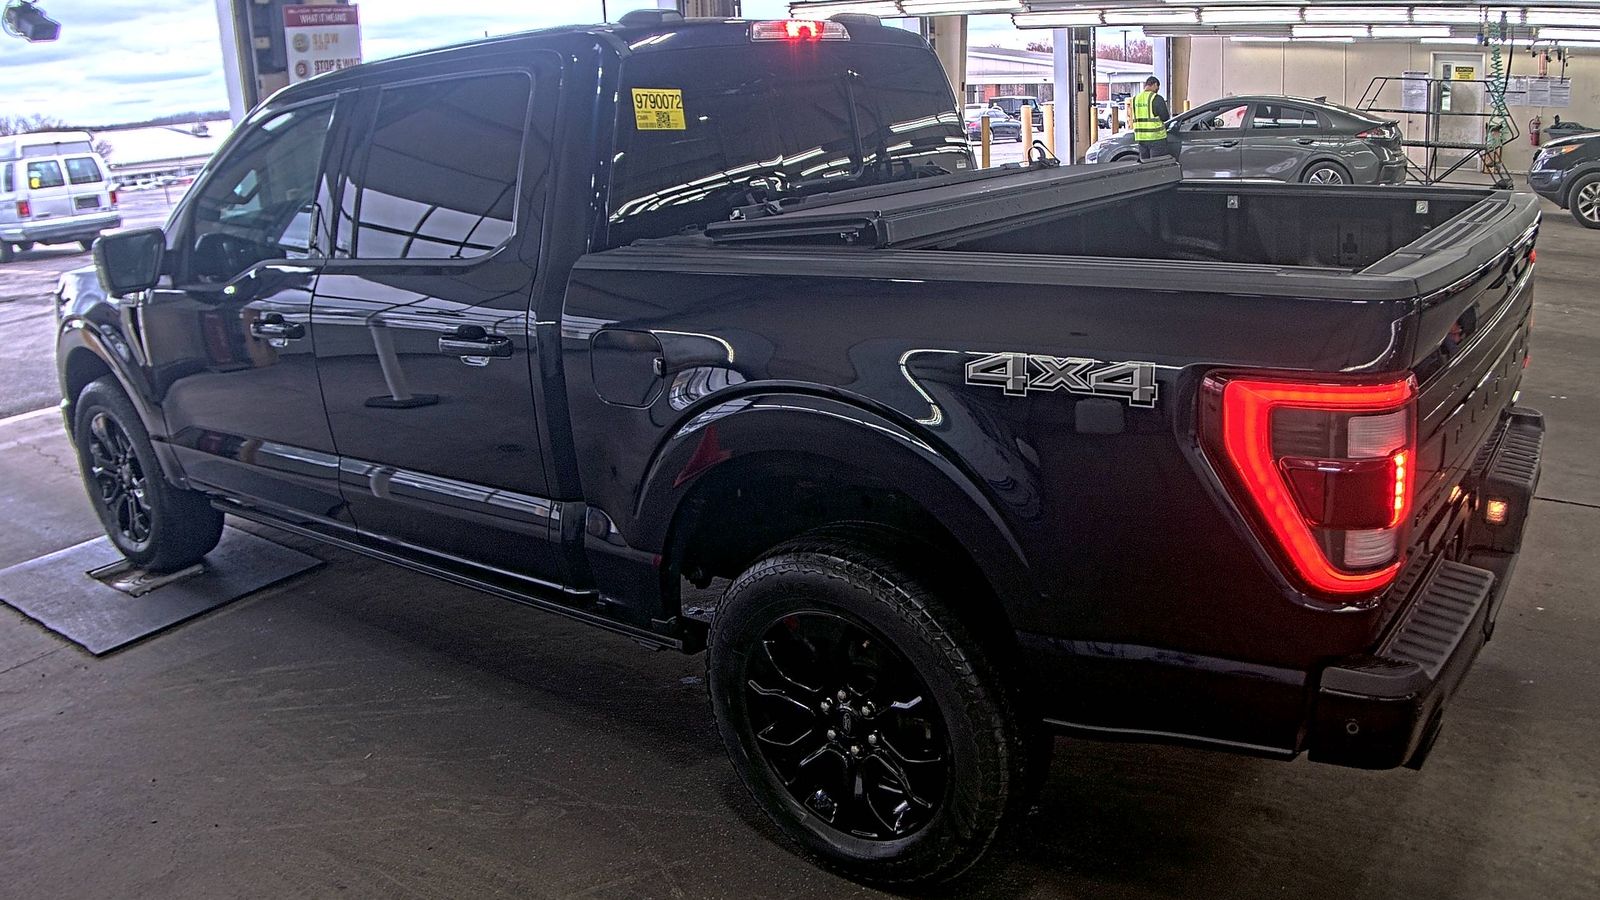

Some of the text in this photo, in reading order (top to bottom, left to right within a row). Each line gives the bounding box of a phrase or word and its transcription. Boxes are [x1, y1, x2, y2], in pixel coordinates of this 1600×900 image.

[299, 14, 318, 24] WHAT
[312, 33, 339, 45] SLOW
[314, 60, 335, 71] STOP
[335, 59, 342, 69] &
[635, 93, 682, 109] 9790072
